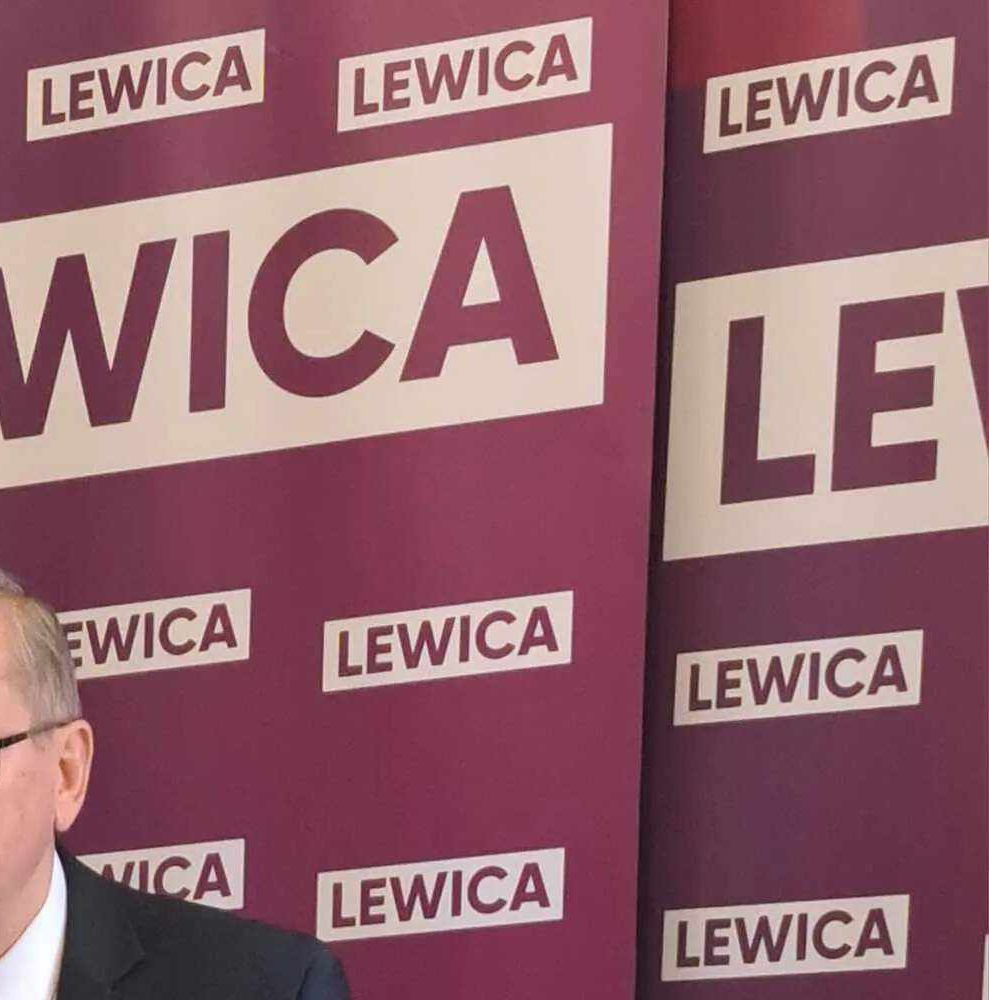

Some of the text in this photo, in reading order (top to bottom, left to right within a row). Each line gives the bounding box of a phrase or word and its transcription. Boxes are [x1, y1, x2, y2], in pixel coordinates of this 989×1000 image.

[42, 46, 252, 125] LEWICA
[354, 34, 577, 116] LEWICA
[719, 55, 938, 137] LEWICA
[720, 285, 989, 505] LE
[338, 606, 558, 677] LEWICA
[689, 645, 907, 711] LEWICA
[101, 853, 231, 900] ICA
[332, 863, 550, 928] LEWICA
[676, 908, 894, 968] LEWICA
